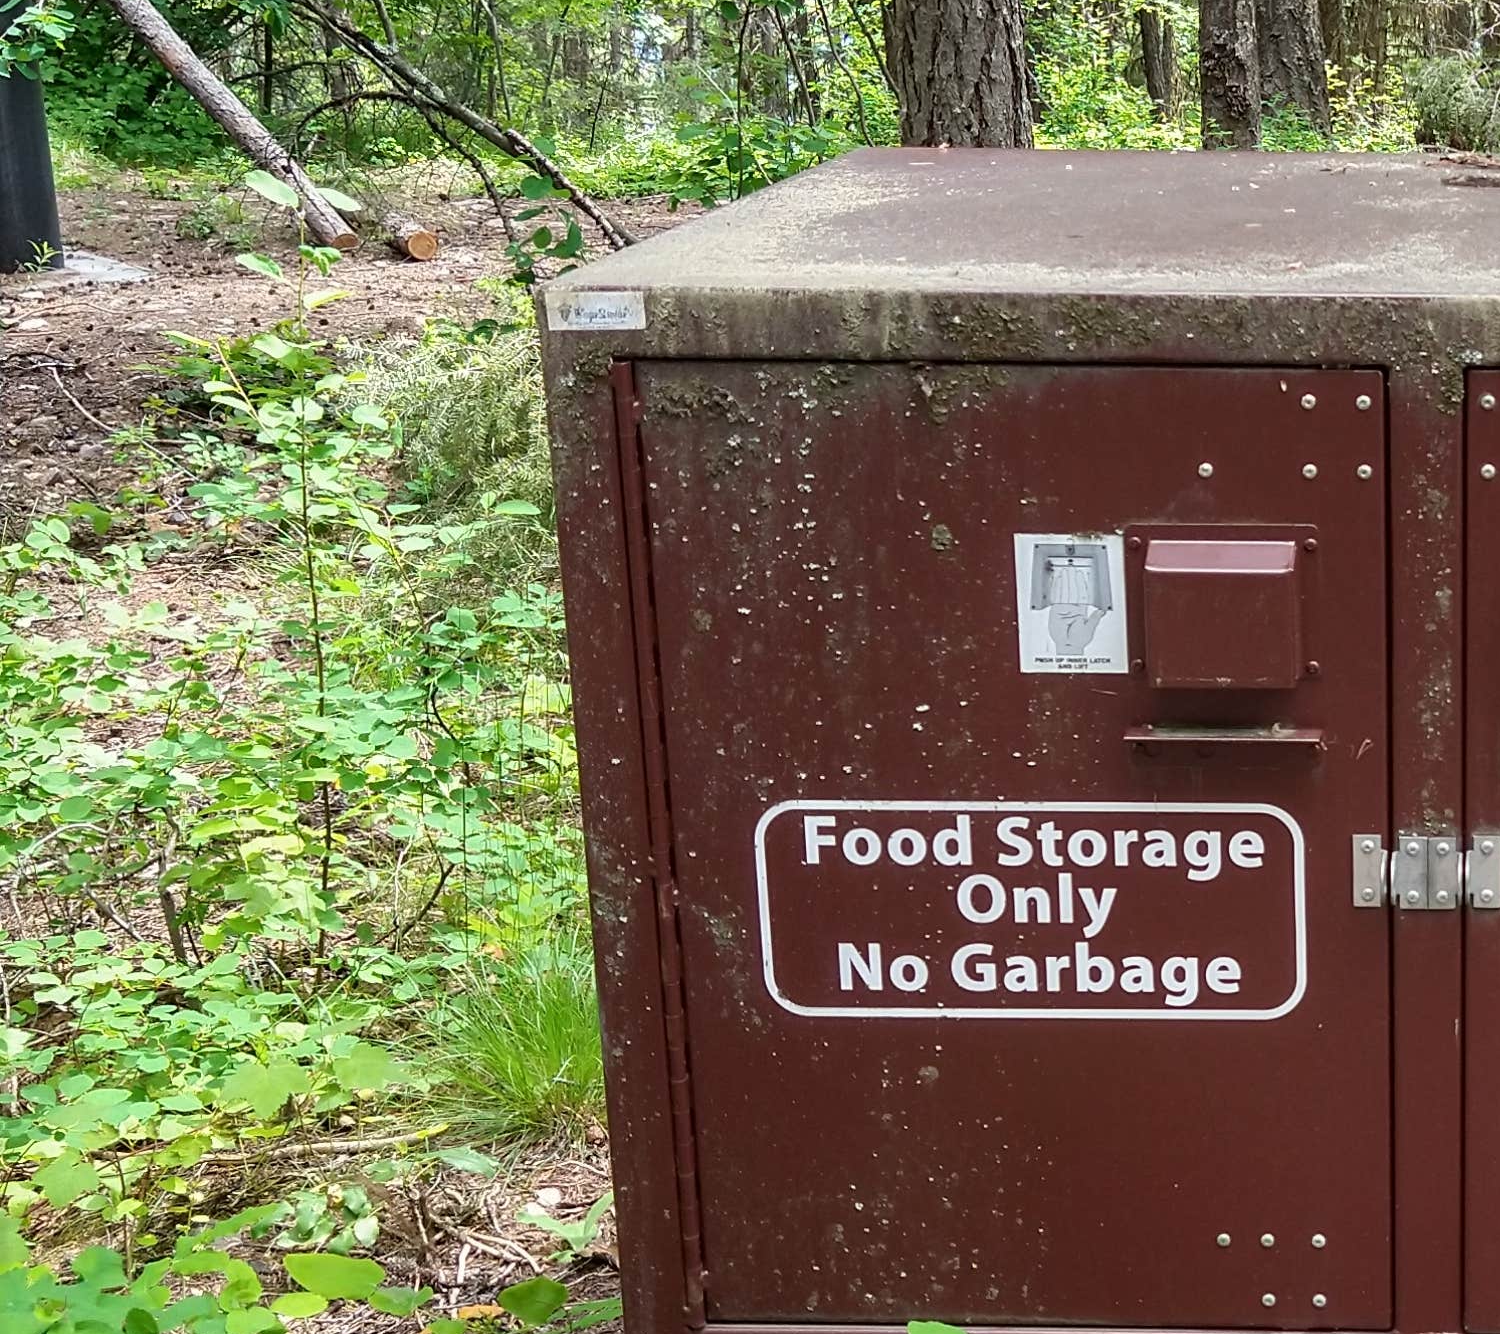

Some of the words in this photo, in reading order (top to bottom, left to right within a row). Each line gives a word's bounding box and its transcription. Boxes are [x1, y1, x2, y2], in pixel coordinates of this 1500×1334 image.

[803, 815, 972, 866] Food
[996, 817, 1265, 880] Storage
[956, 873, 1117, 937] Only
[838, 942, 928, 992] No
[951, 942, 1242, 1006] Garbage
